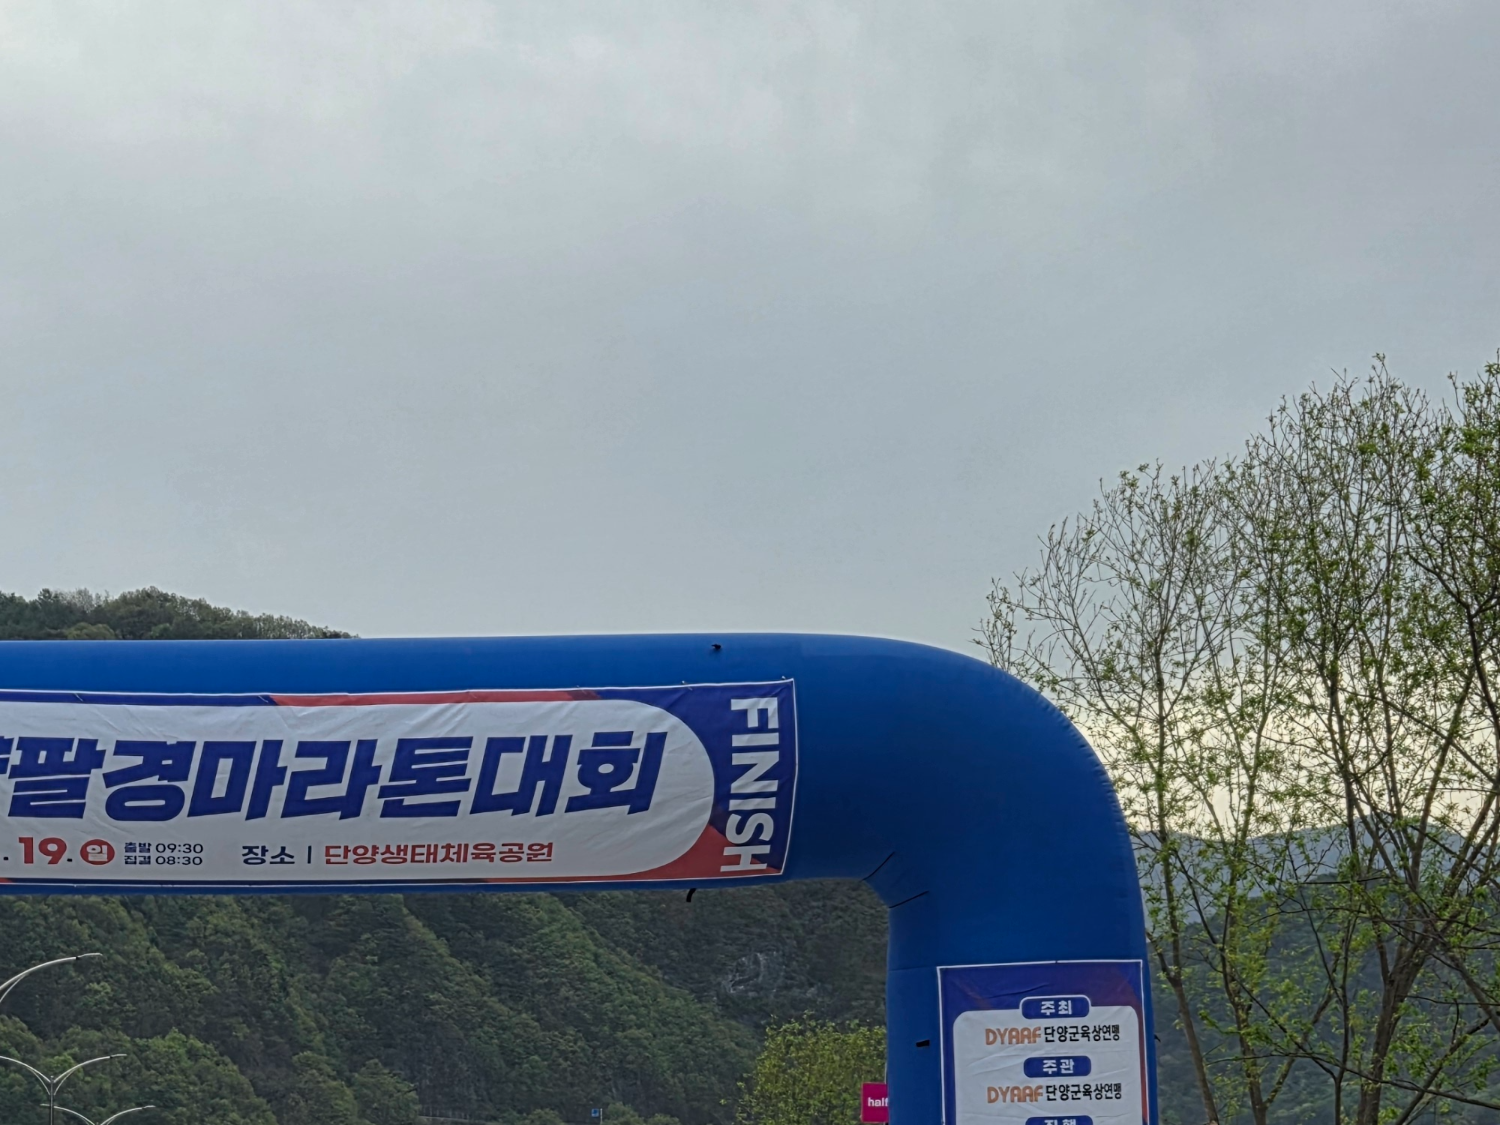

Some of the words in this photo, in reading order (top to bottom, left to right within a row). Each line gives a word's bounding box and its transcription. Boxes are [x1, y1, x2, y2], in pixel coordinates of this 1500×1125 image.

[721, 697, 780, 873] FINISH
[124, 842, 152, 854] 출발
[155, 843, 204, 854] 09:30
[241, 844, 296, 866] 장소
[323, 841, 555, 866] 단양생태체육공원
[124, 855, 151, 866] 집결
[155, 855, 203, 866] 08:30
[1040, 999, 1073, 1016] 주최
[985, 1027, 1042, 1045] DYAAF
[1044, 1024, 1121, 1043] 단양군육상연맹
[1042, 1058, 1075, 1075] 주관
[986, 1085, 1044, 1104] DYAAF
[1045, 1082, 1122, 1101] 단양군육상연맹
